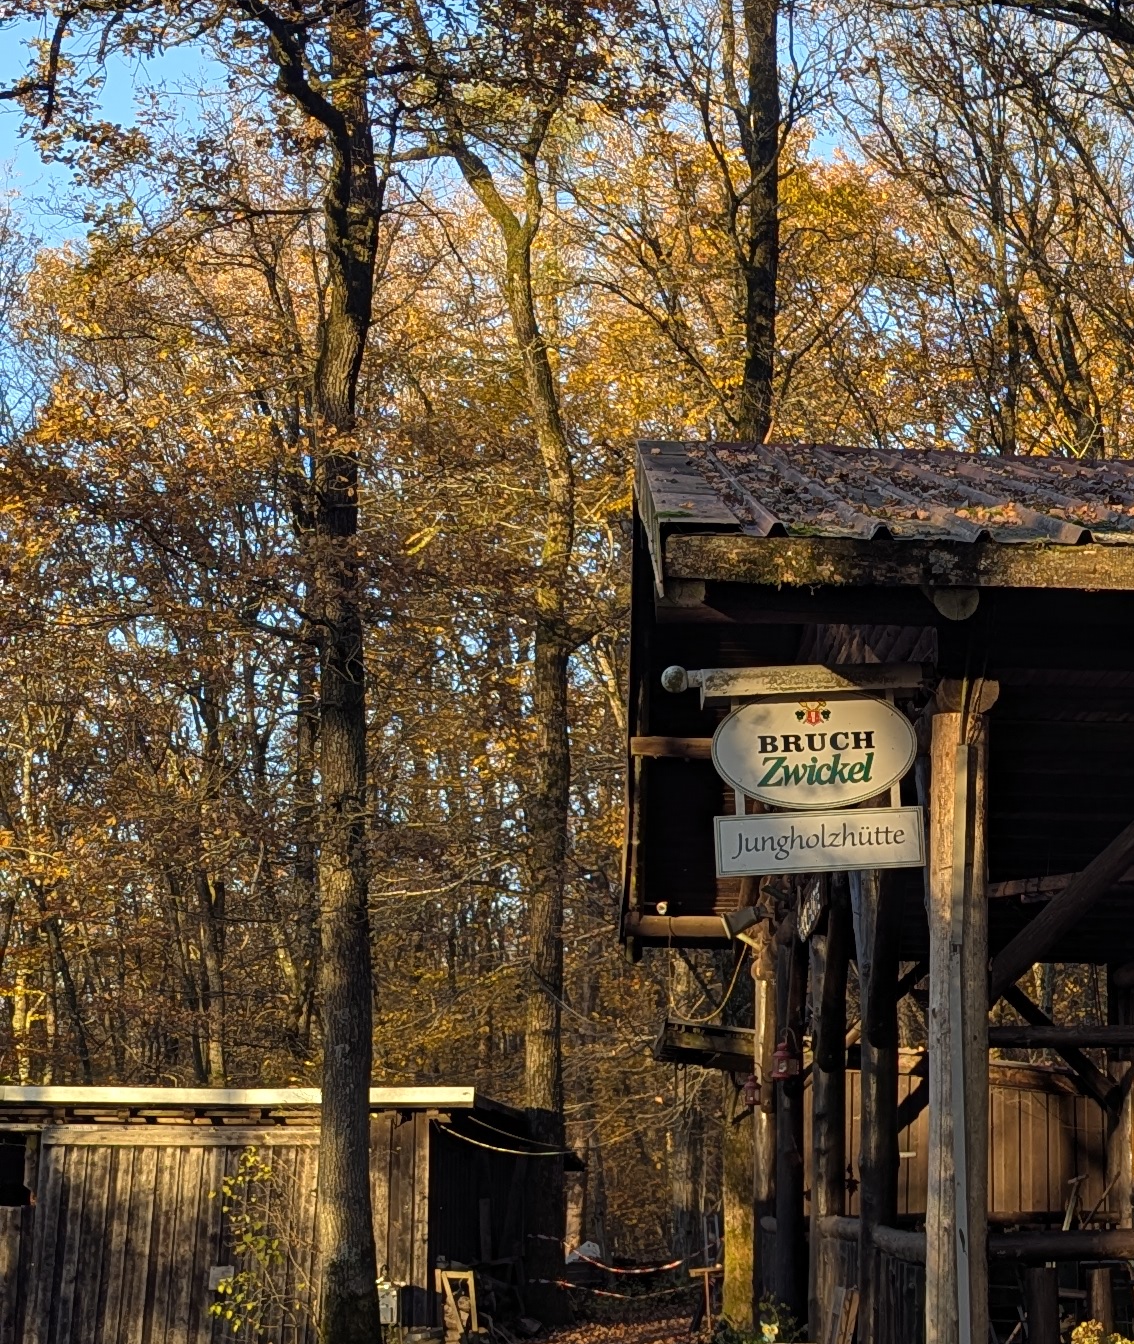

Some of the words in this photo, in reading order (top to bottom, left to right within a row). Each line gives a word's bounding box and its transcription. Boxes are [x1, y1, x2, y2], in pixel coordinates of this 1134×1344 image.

[757, 731, 876, 754] BRUCH
[757, 751, 875, 788] Zwickel
[731, 822, 906, 861] Jungholzhütte
